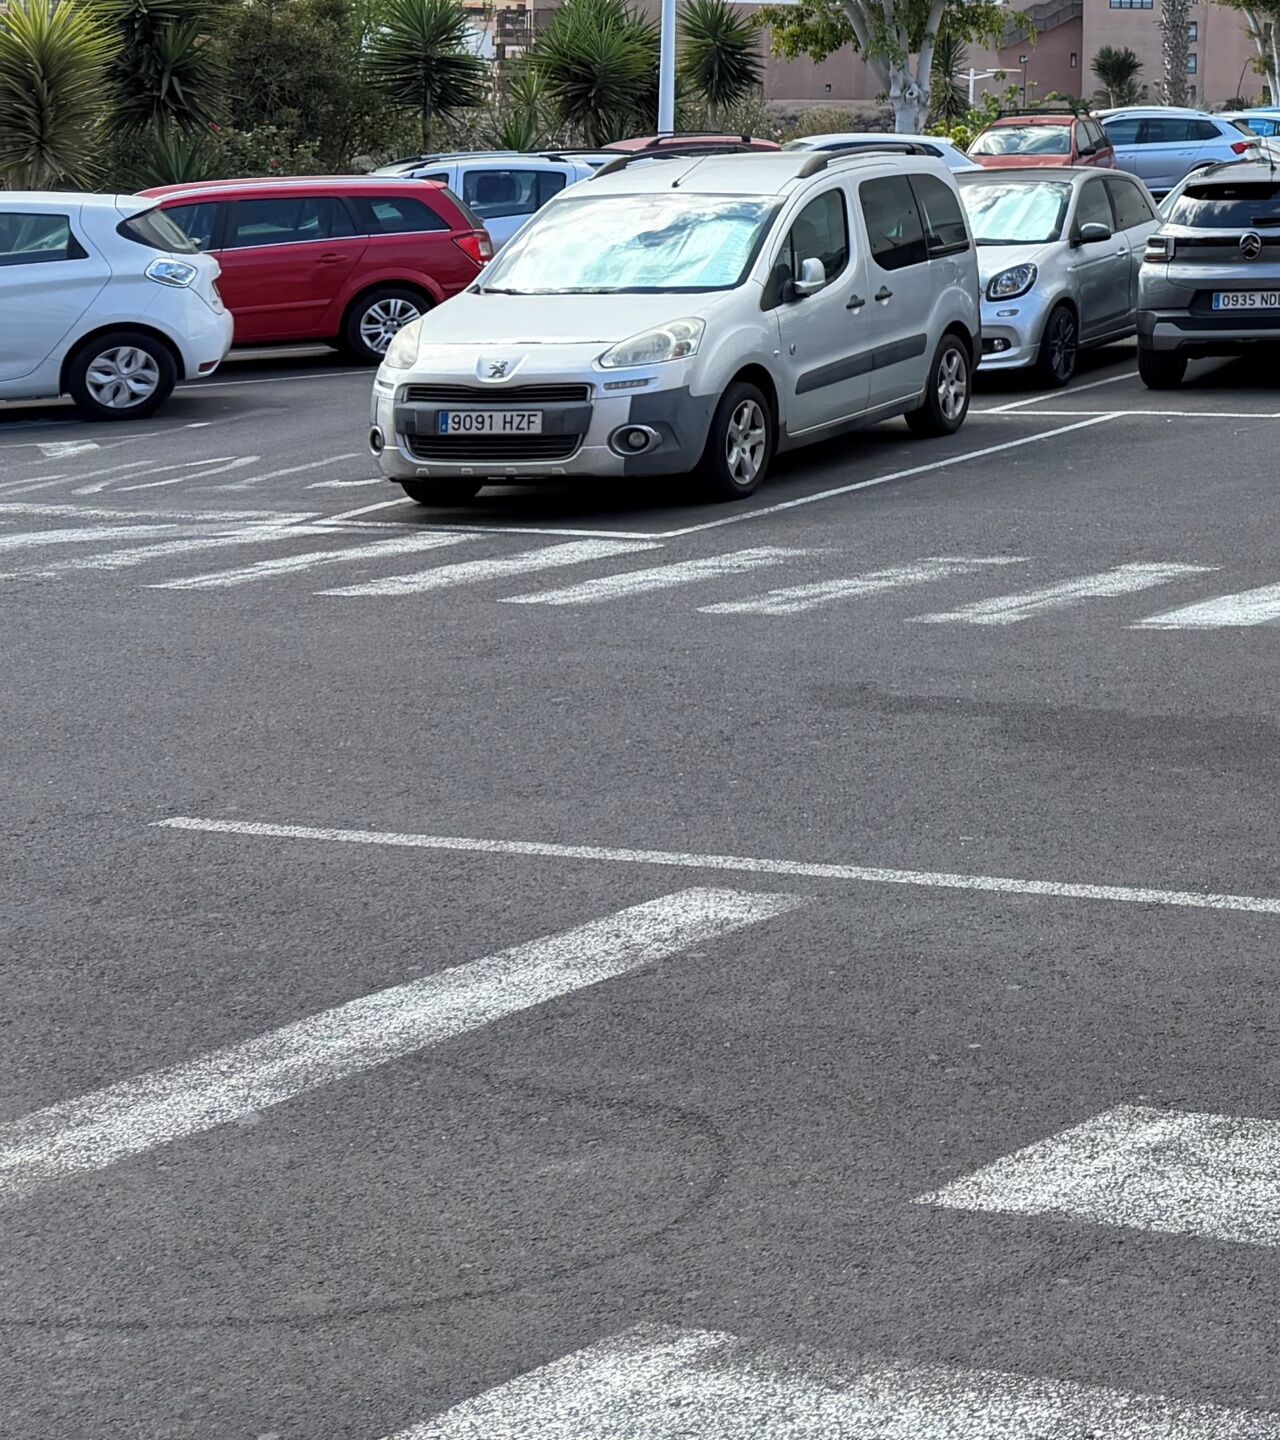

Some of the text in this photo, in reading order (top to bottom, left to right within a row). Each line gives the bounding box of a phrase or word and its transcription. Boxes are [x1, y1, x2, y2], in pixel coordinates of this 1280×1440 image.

[1222, 294, 1256, 307] 0935
[451, 414, 538, 431] 9091 HZF
